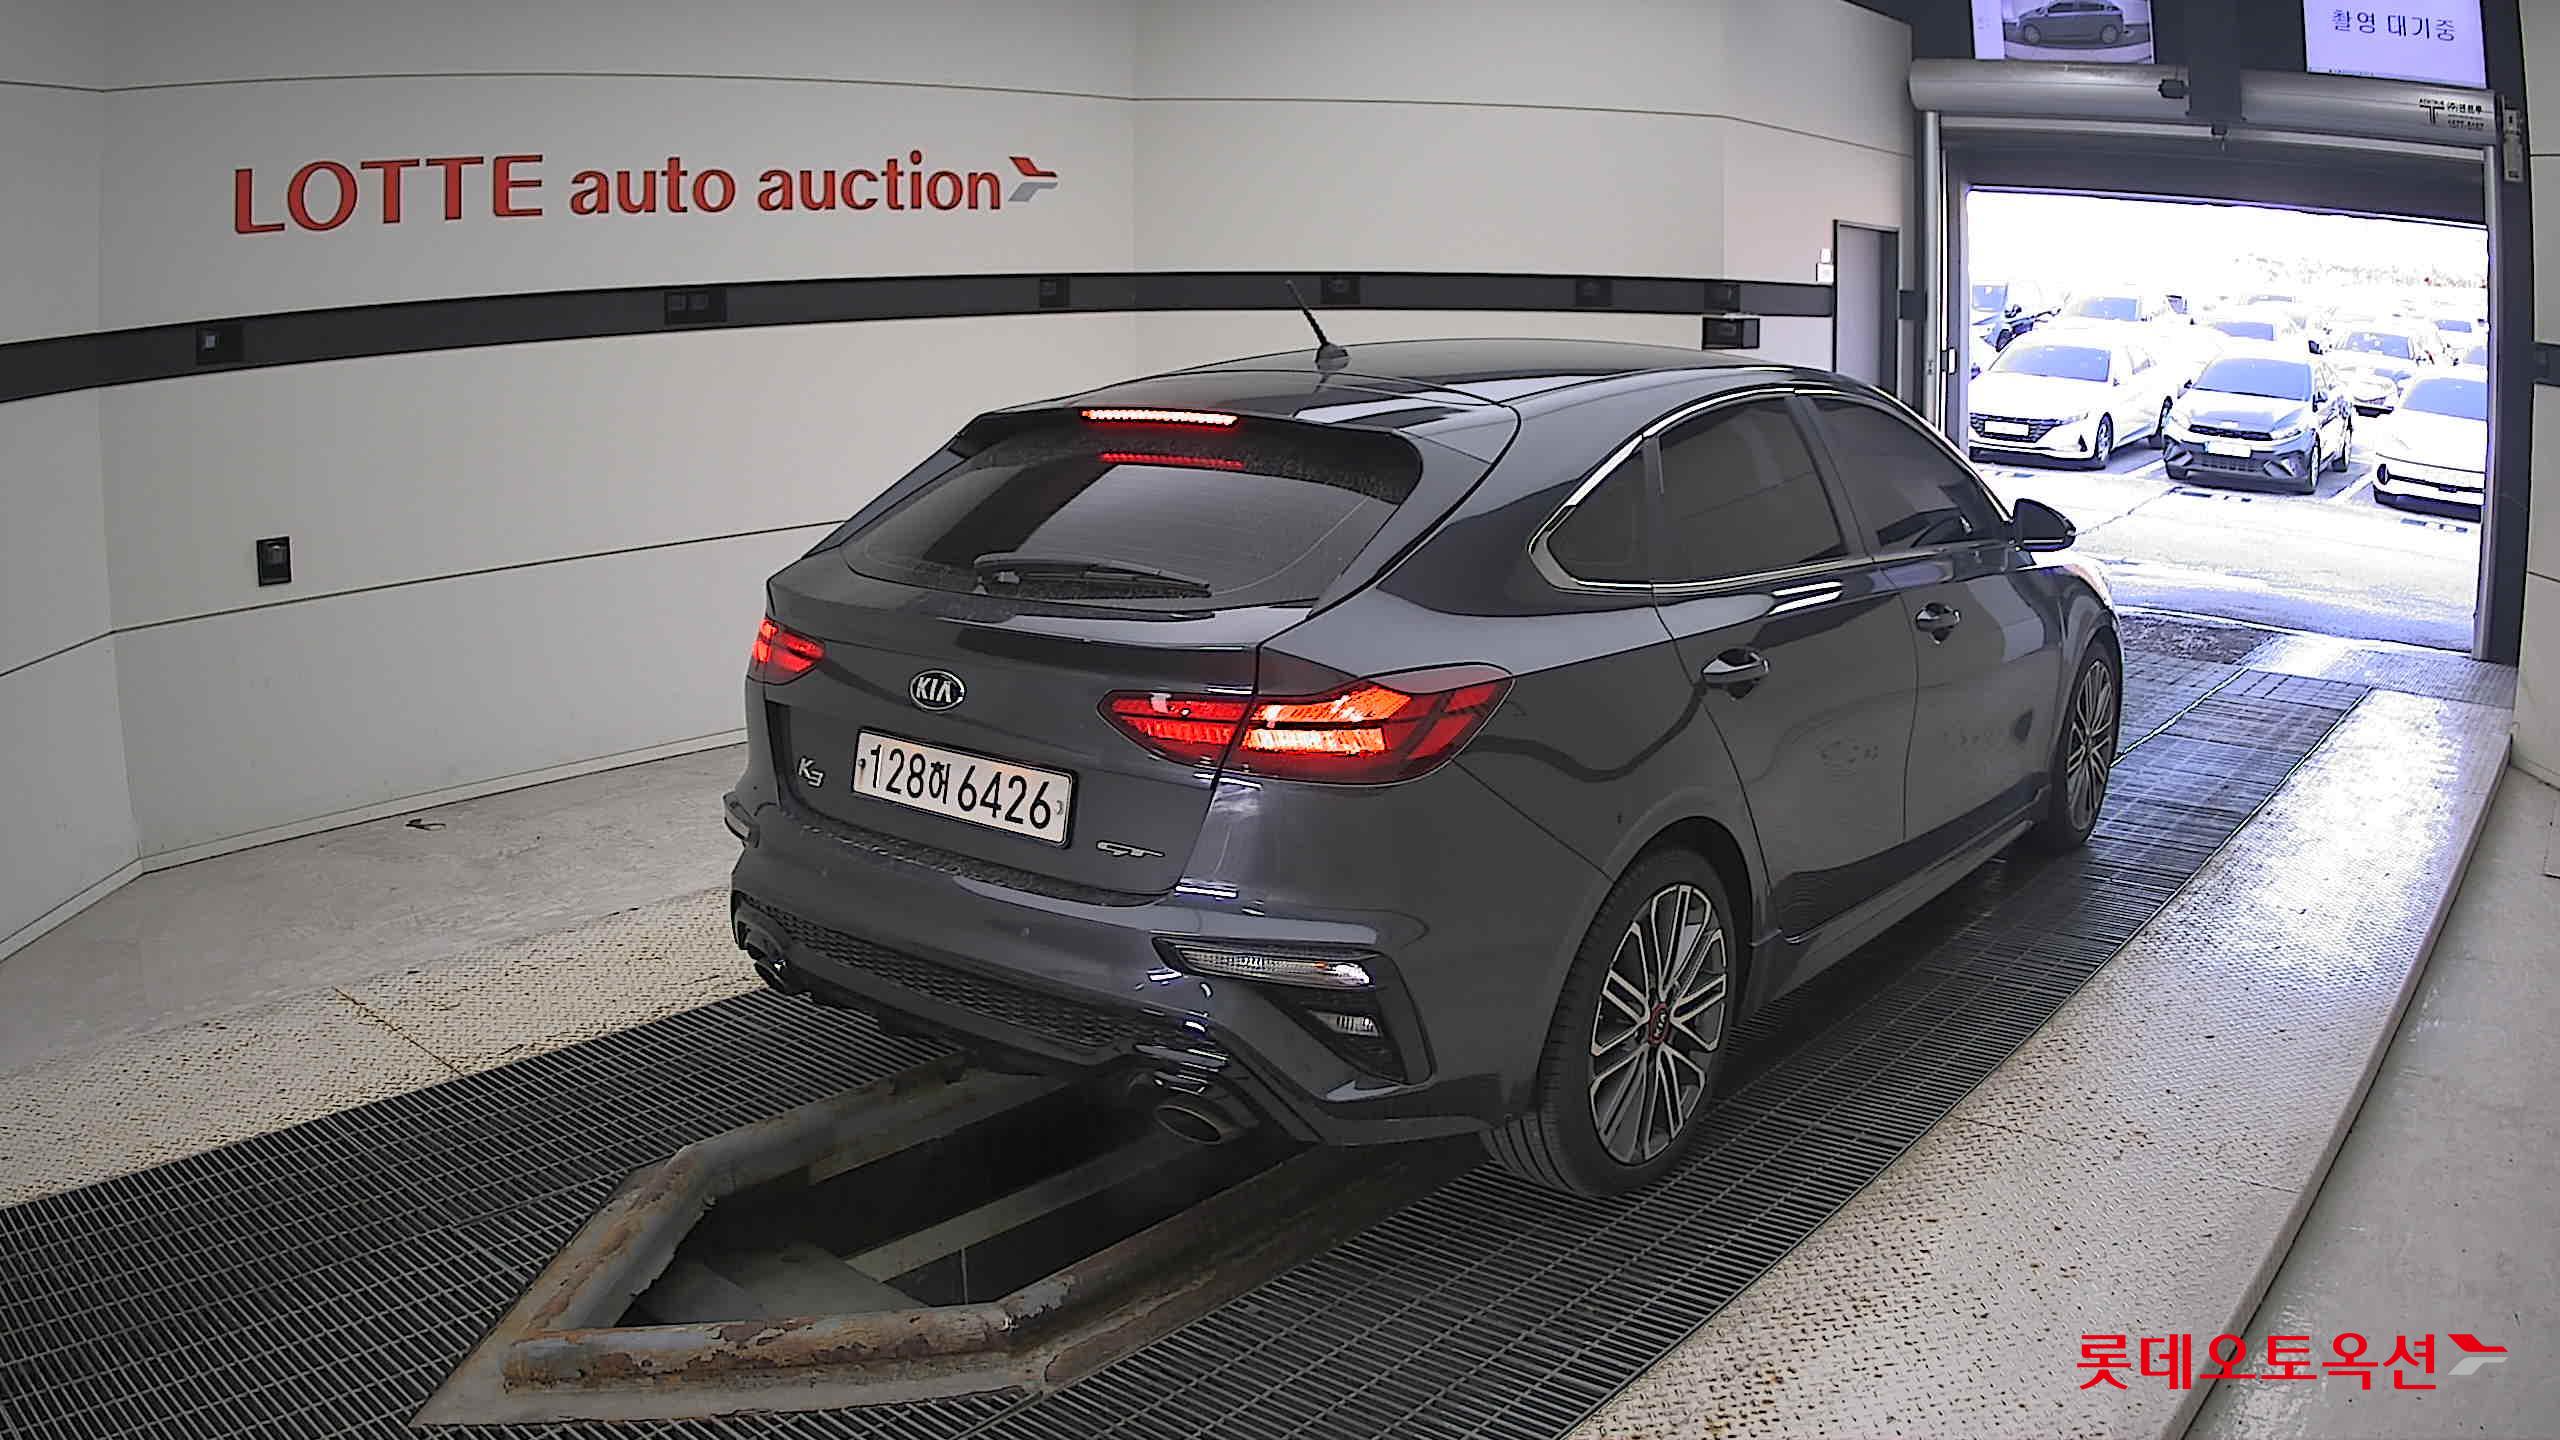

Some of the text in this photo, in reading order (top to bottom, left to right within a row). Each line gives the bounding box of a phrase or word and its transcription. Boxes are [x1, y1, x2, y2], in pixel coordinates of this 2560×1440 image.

[2332, 9, 2456, 42] 촬영 대기중
[234, 149, 1001, 234] LOTTE auto auction
[915, 676, 954, 703] KIA
[798, 757, 824, 787] K3
